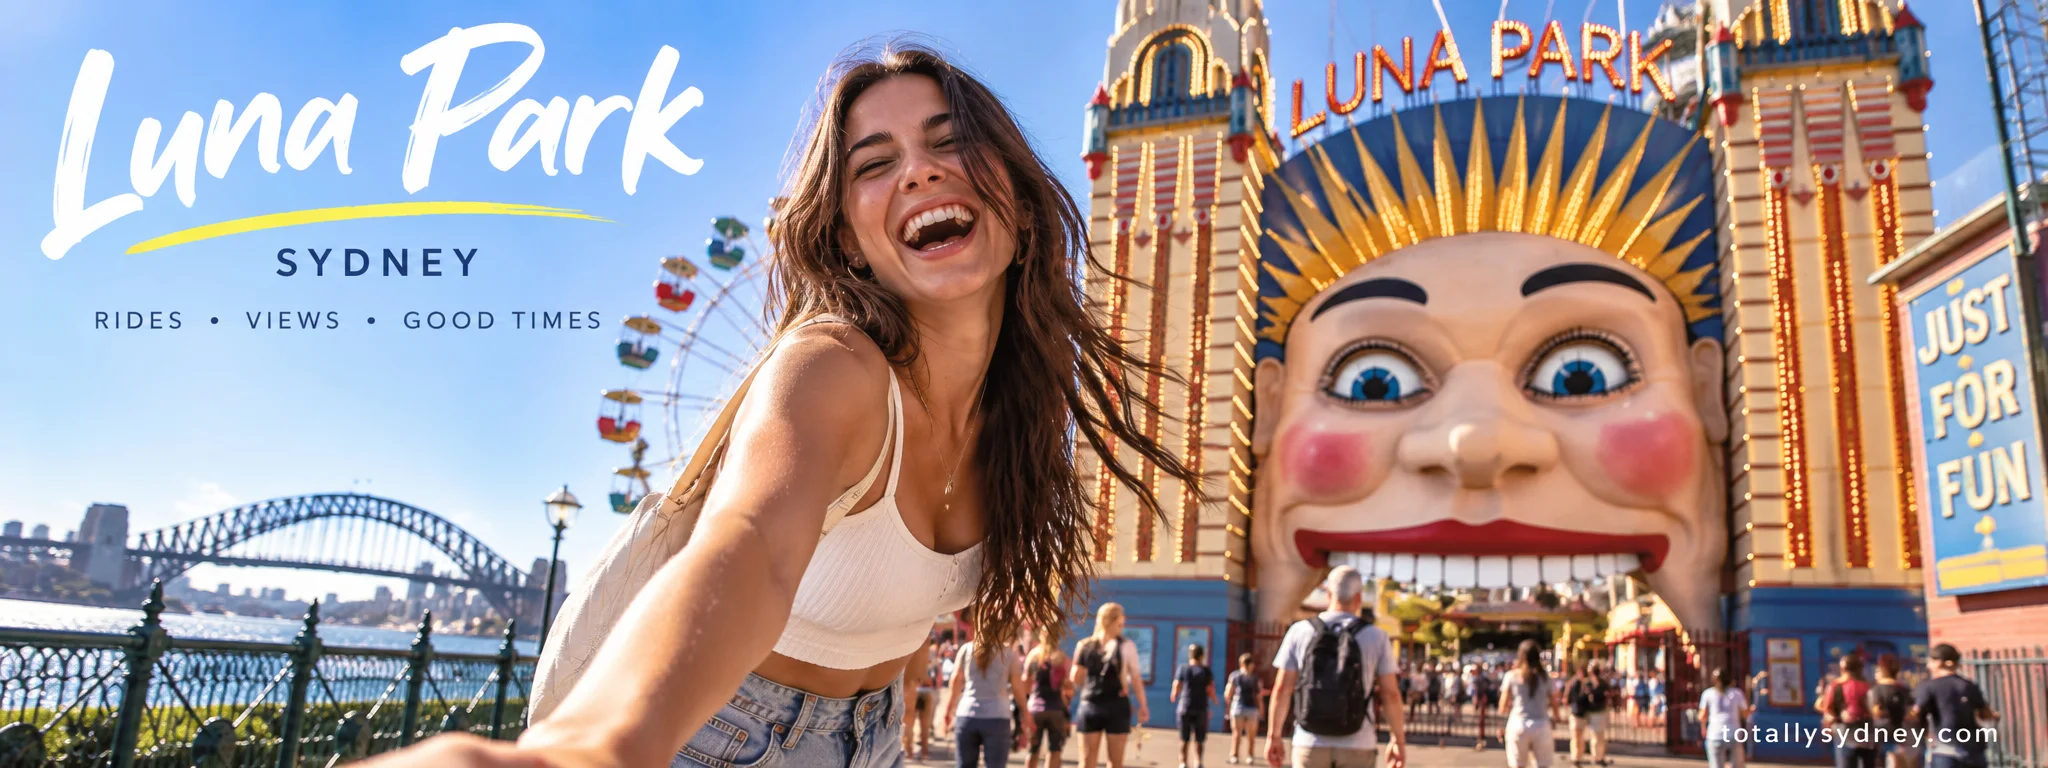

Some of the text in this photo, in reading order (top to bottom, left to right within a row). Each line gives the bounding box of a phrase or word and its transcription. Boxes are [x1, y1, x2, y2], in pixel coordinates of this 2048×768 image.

[1291, 20, 1676, 138] LUNA PARK
[1918, 274, 2010, 366] JUST
[1930, 359, 2020, 440] FOR
[1937, 441, 2030, 519] FUN
